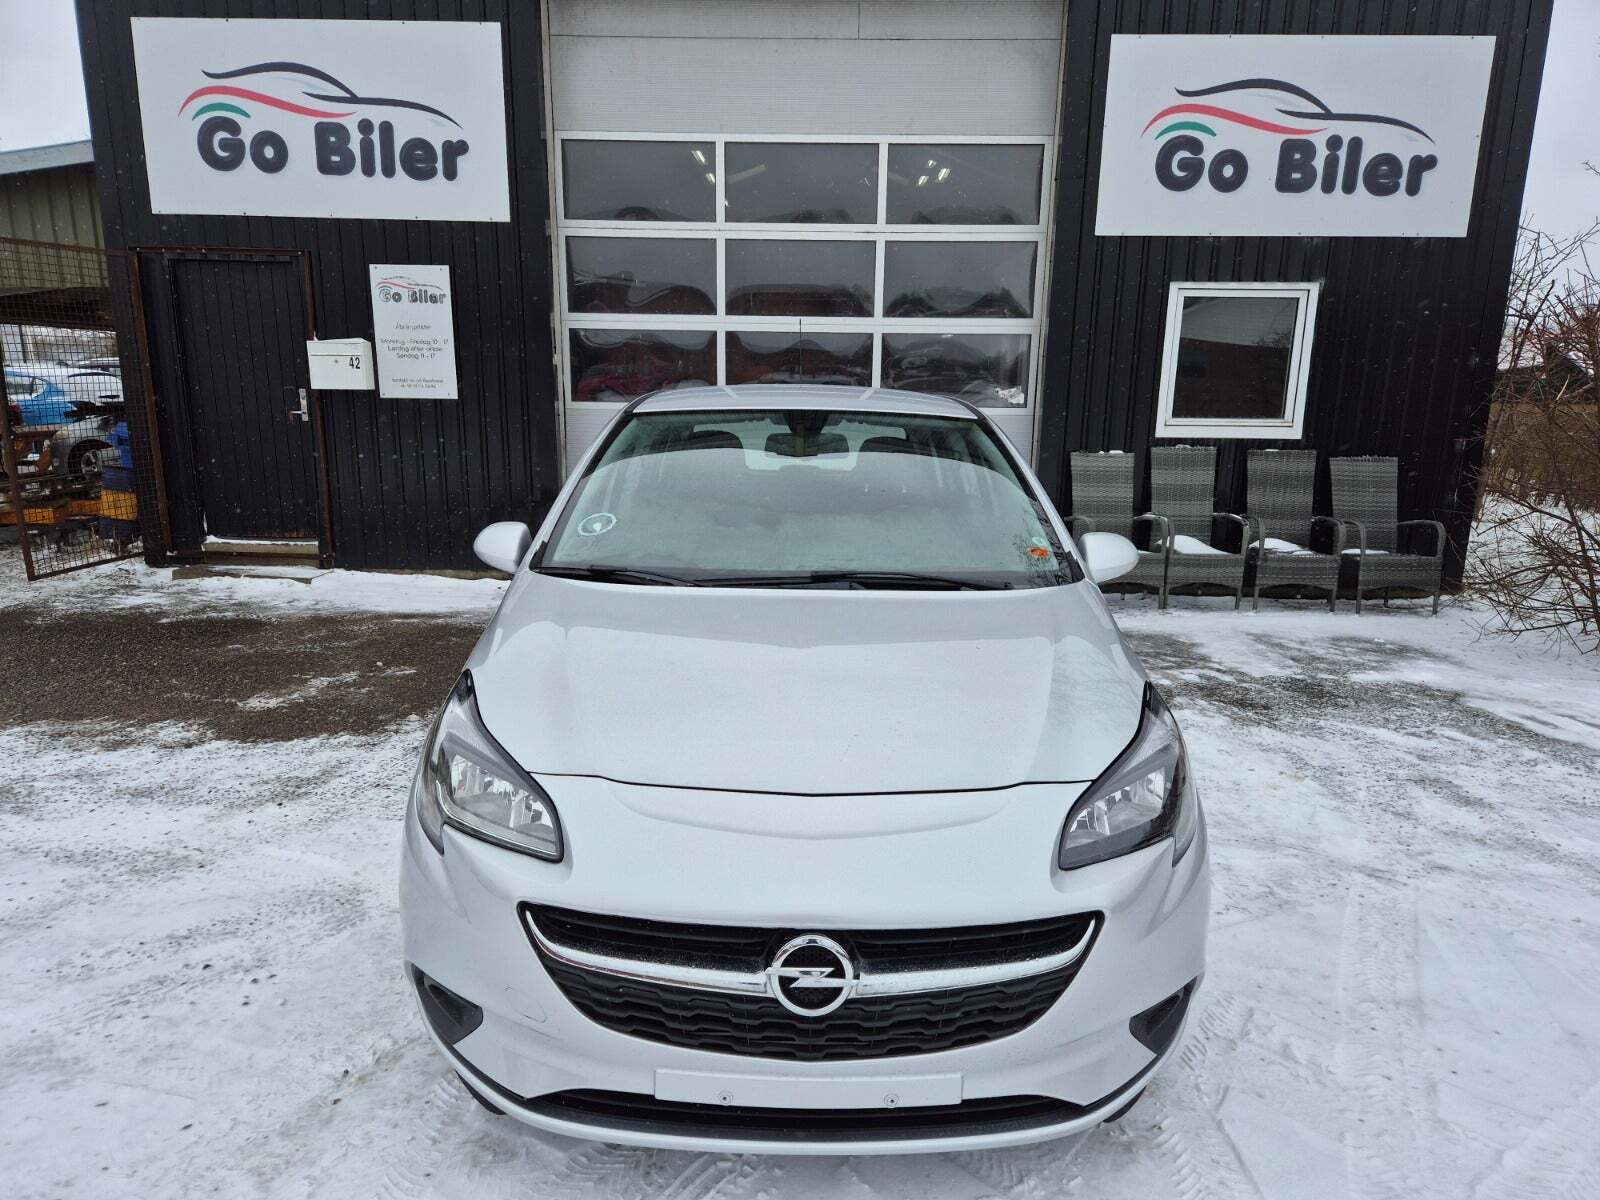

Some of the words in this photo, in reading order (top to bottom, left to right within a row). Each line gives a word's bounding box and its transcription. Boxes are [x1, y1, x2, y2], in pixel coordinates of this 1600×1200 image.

[197, 115, 289, 173] Go
[314, 118, 469, 181] Biler
[1155, 134, 1248, 193] Go
[1275, 134, 1437, 197] Biler
[379, 289, 402, 303] Go
[408, 289, 447, 304] Biler
[349, 357, 361, 370] 42
